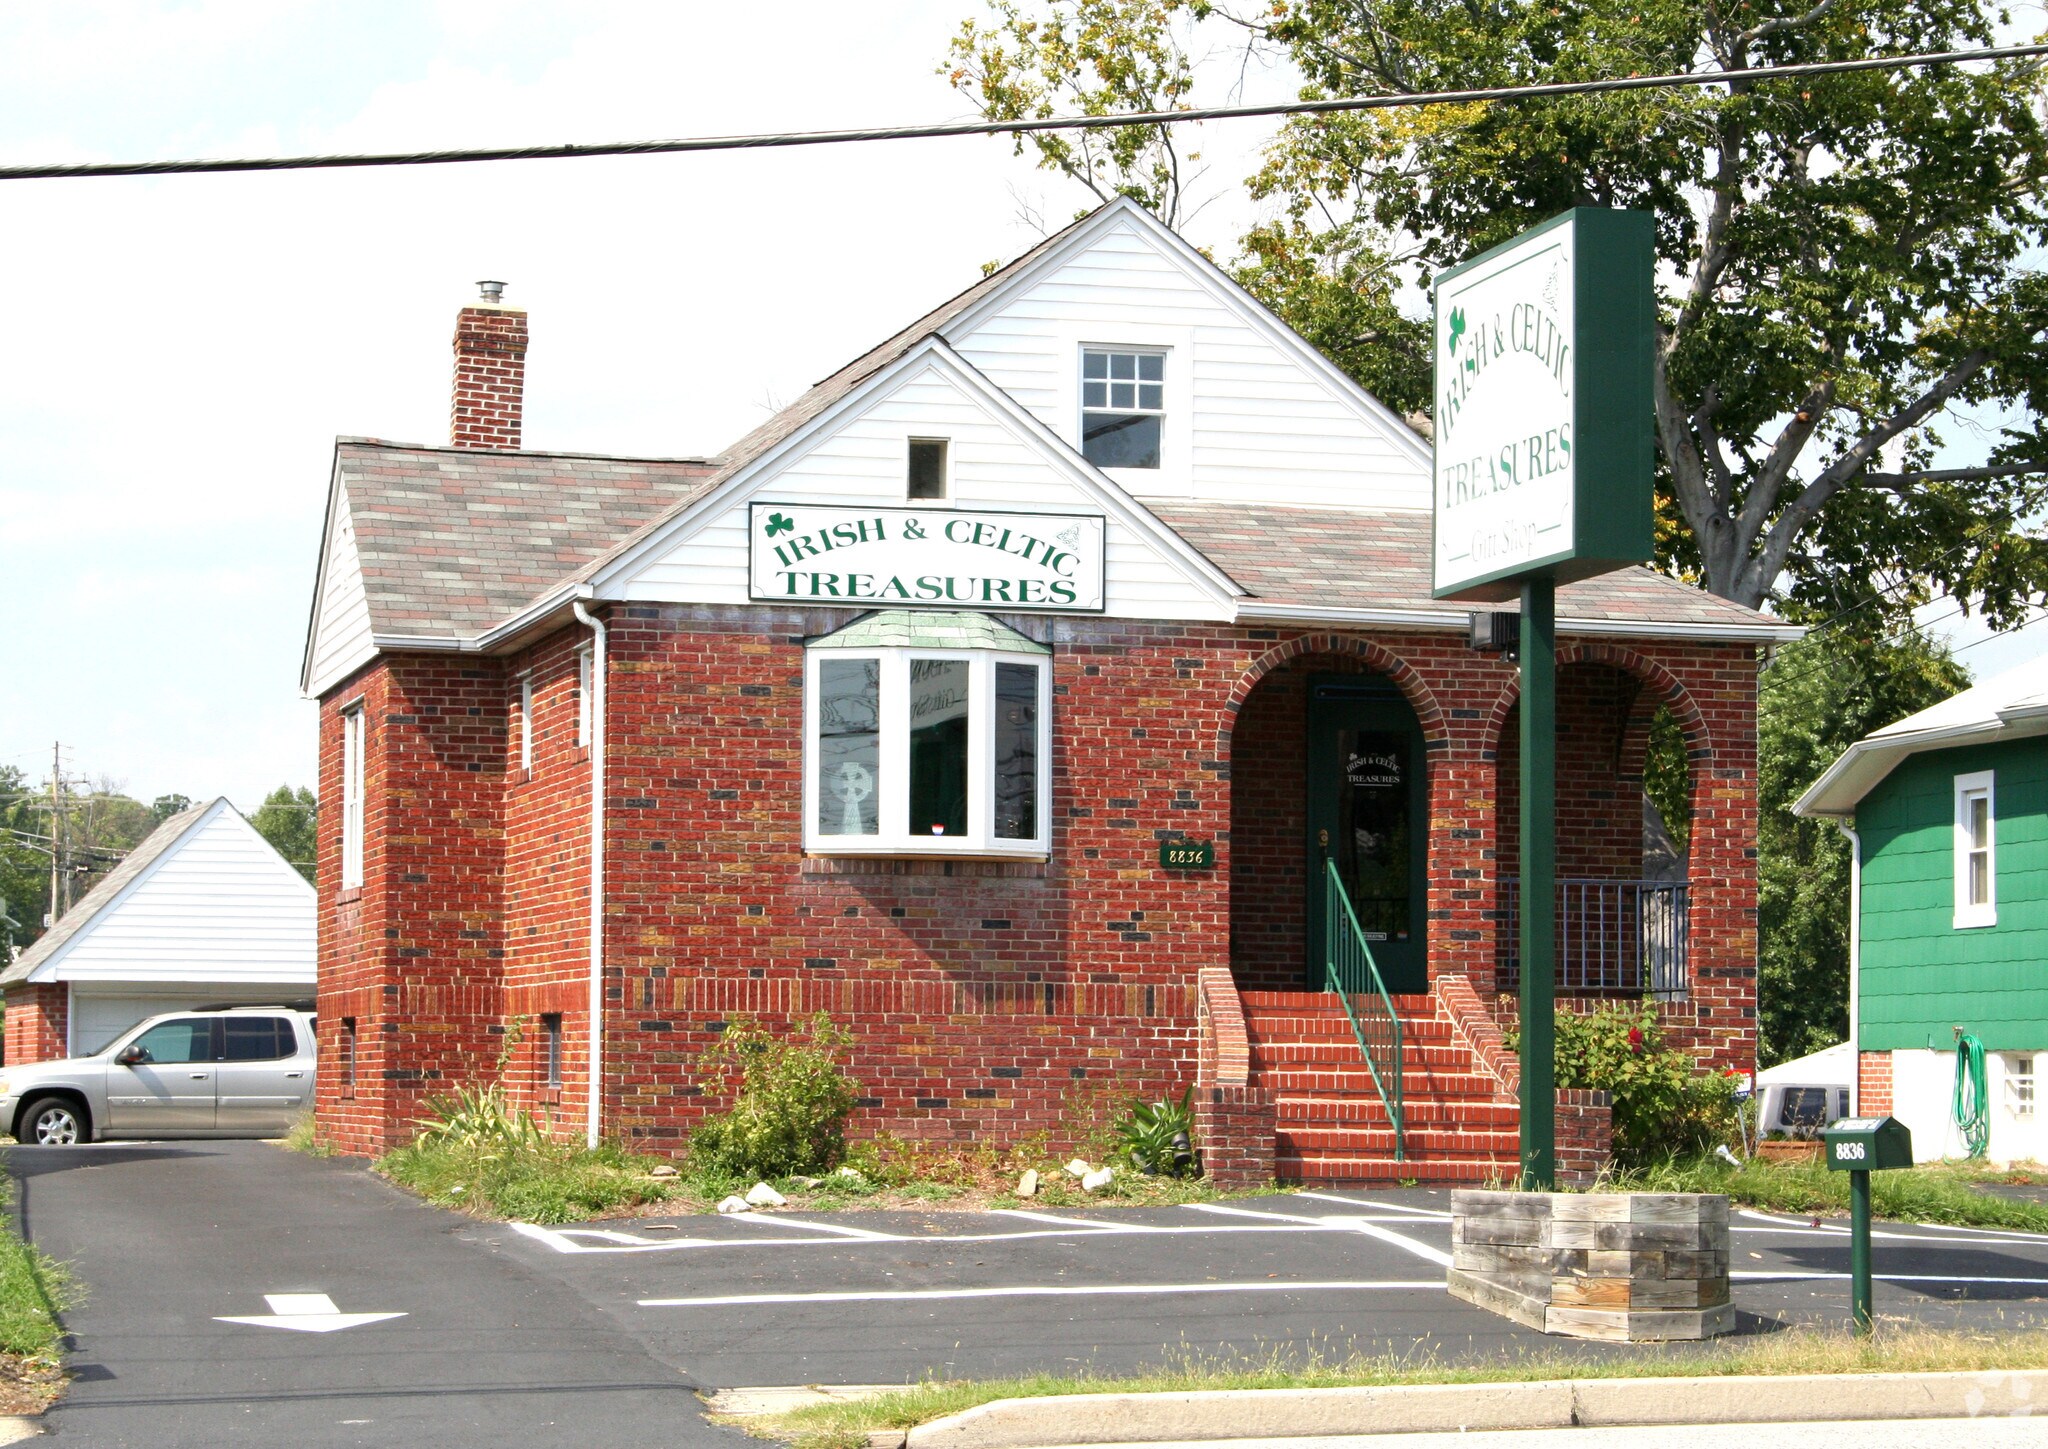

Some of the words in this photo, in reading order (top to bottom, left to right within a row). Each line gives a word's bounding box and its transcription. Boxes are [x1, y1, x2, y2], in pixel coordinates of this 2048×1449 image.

[1440, 322, 1488, 445] IRISH
[1493, 312, 1505, 359] &
[1511, 302, 1572, 398] CELTIC
[1442, 422, 1571, 509] TREASURES
[772, 517, 887, 568] IRISH
[902, 517, 930, 540] &
[944, 518, 1081, 578] CELTIC
[775, 571, 1078, 605] TREASURES
[1346, 757, 1366, 773] IRISH
[1375, 757, 1400, 774] CELTIC
[1347, 774, 1400, 783] TREASURES
[1169, 850, 1204, 864] 8836
[1836, 1142, 1865, 1160] 8836
